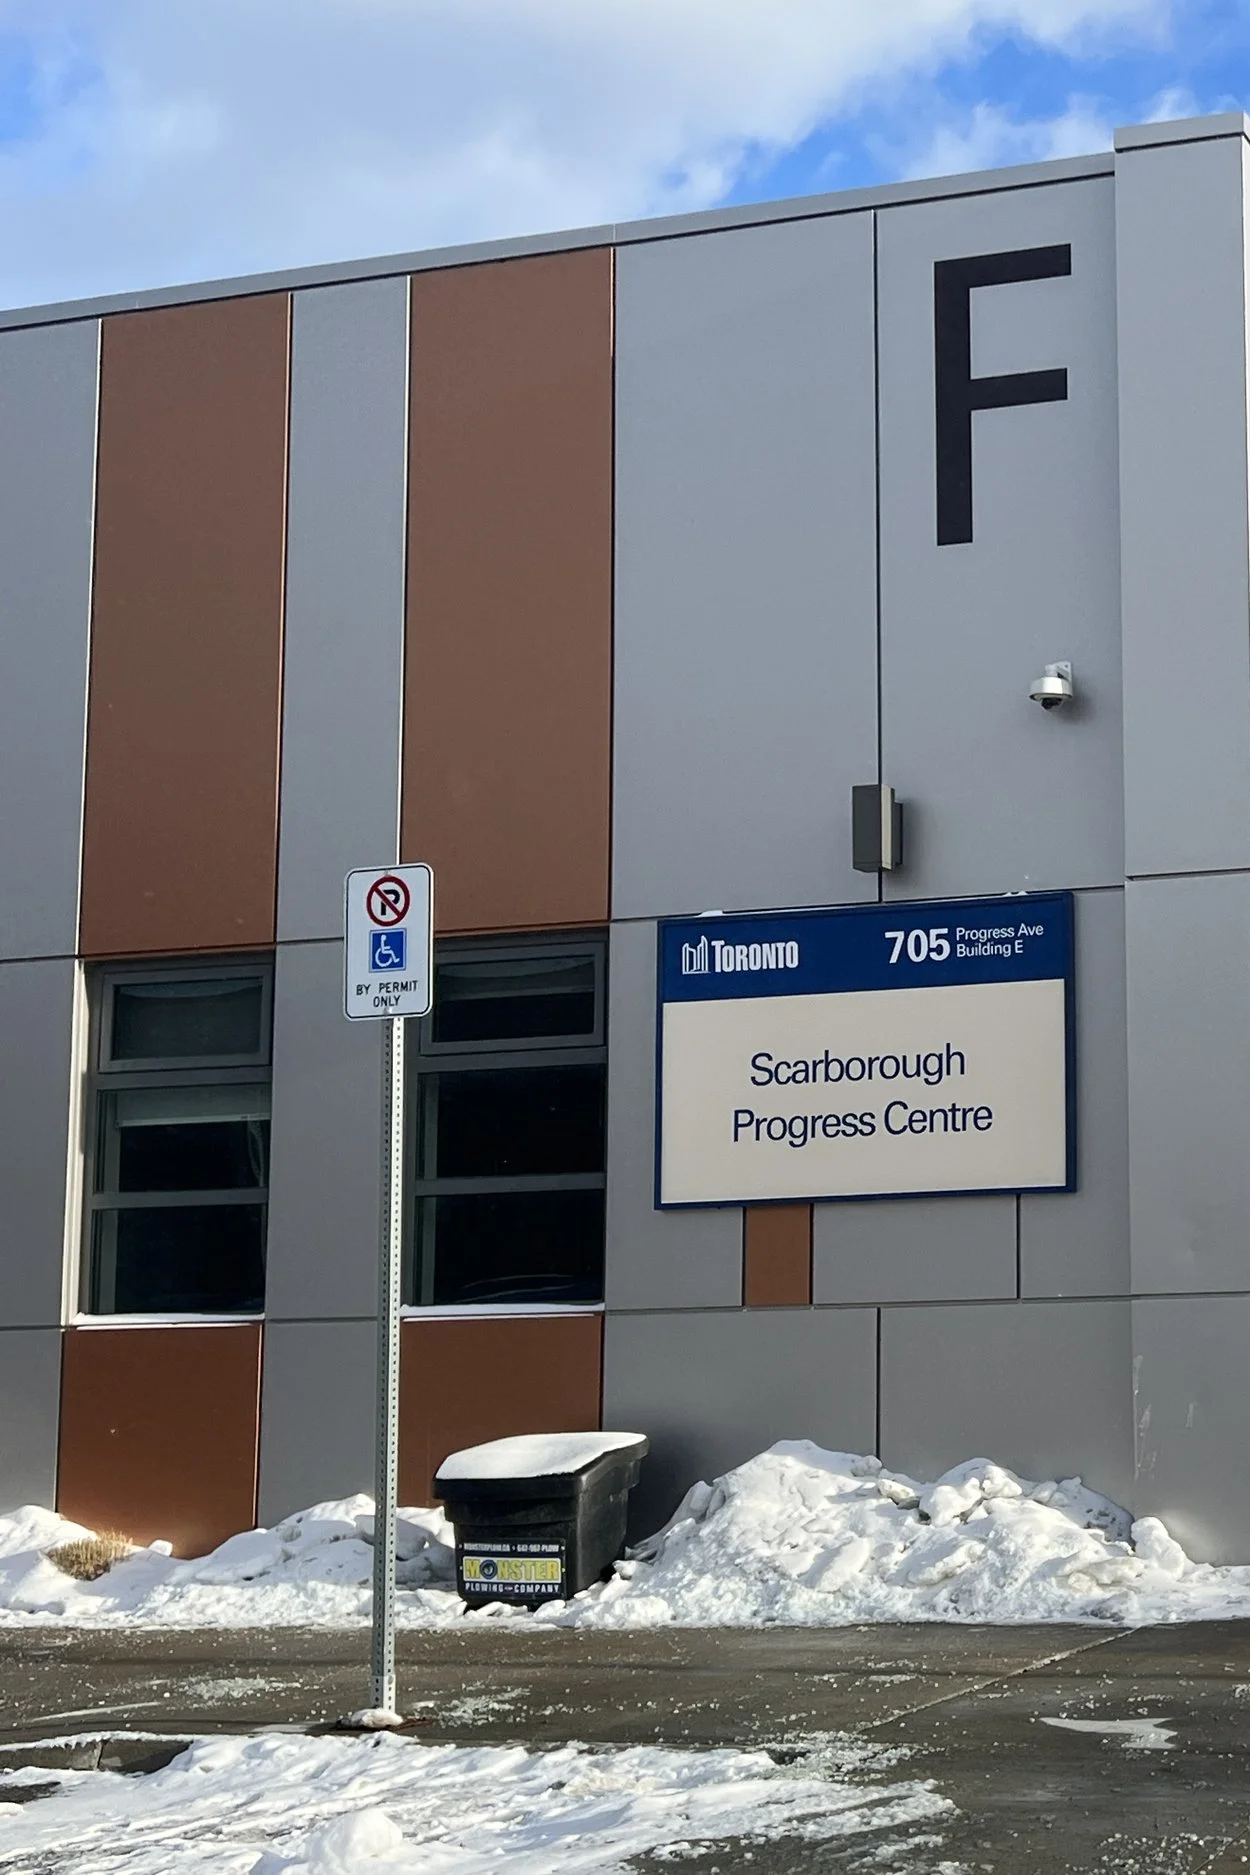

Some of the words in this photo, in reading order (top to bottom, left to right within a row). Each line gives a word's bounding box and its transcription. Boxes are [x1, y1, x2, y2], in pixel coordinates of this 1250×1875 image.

[934, 243, 1071, 546] F
[884, 927, 951, 964] 705
[956, 926, 1015, 943] Progress
[1017, 923, 1044, 937] Ave
[711, 939, 799, 974] TORONTO
[956, 941, 1012, 958] Building
[1014, 940, 1024, 954] E
[356, 984, 371, 996] BY
[378, 980, 419, 994] PERMIT
[373, 995, 401, 1008] ONLY
[750, 1042, 966, 1086] Scarborough
[733, 1108, 876, 1148] Progress
[884, 1100, 993, 1135] Centre
[465, 1582, 504, 1593] PLOWING
[514, 1583, 560, 1593] COMPANY
